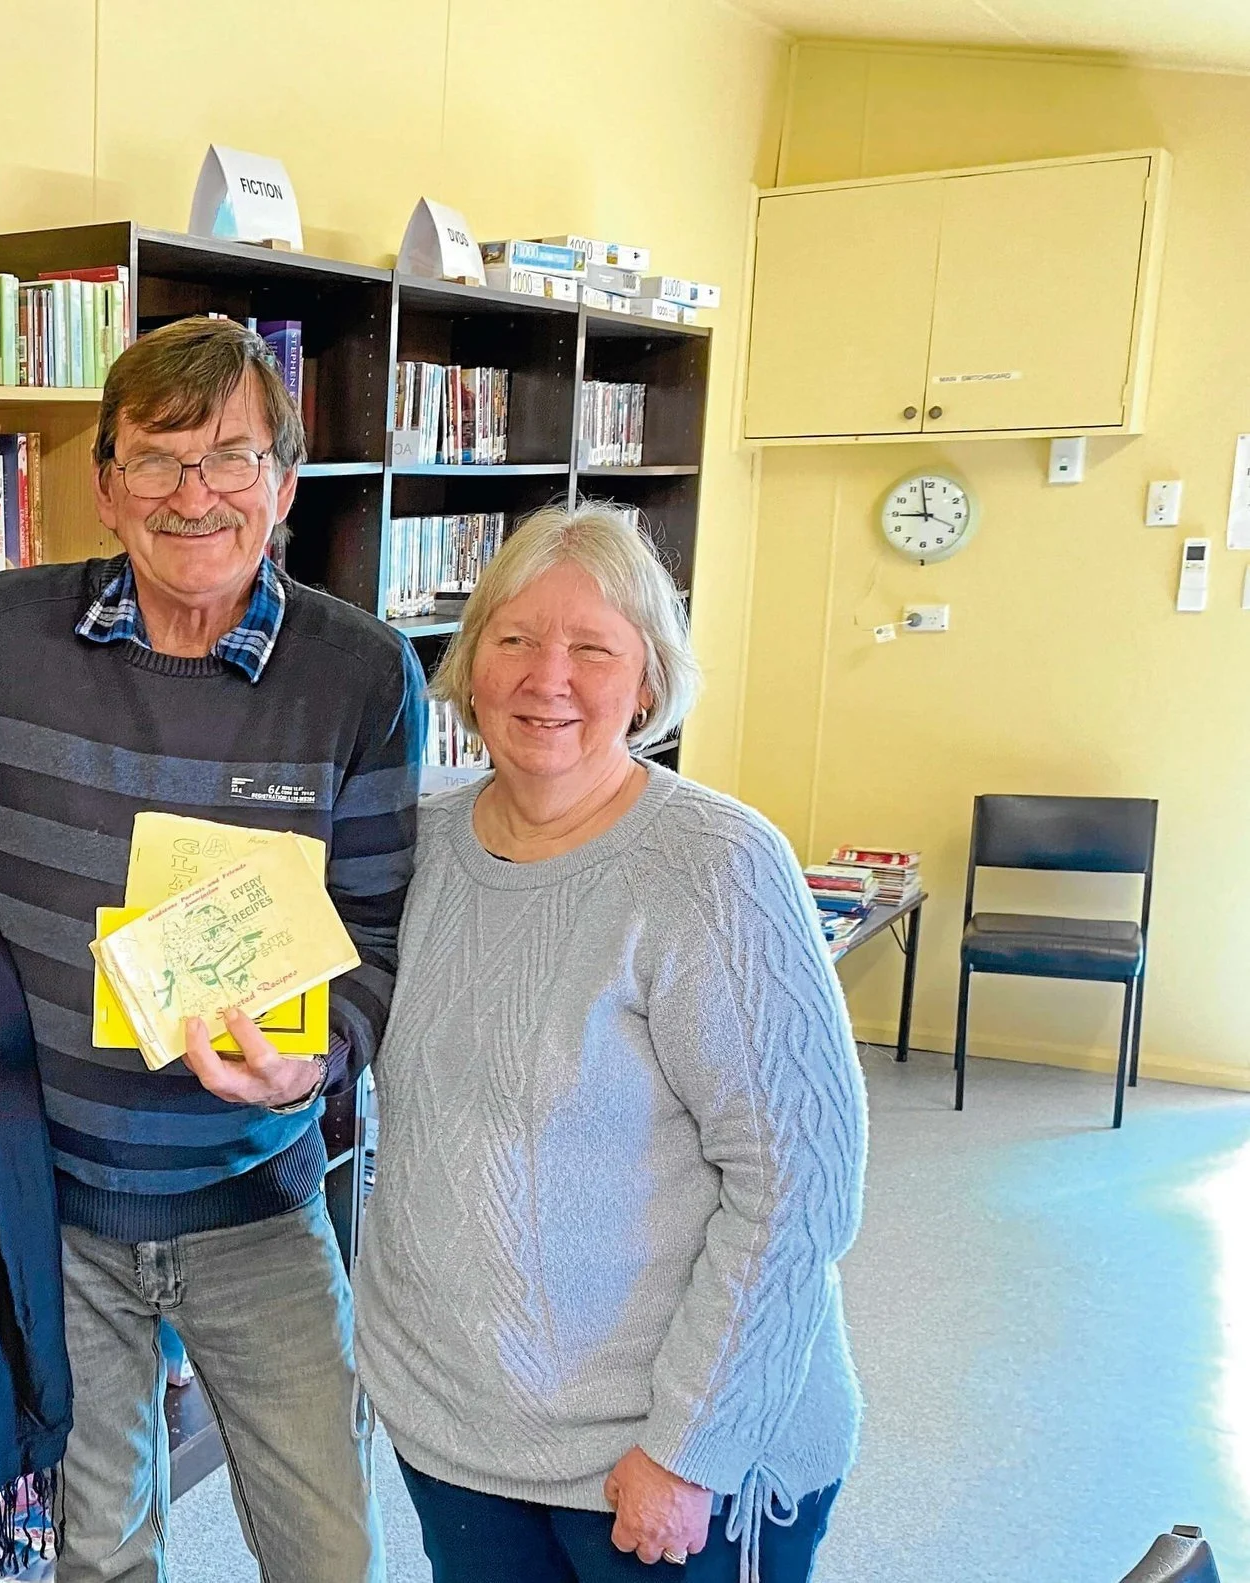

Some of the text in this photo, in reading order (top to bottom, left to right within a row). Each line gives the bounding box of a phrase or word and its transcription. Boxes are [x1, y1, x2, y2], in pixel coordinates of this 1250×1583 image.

[239, 177, 283, 200] FICTION
[447, 228, 469, 247] DVDS
[513, 272, 533, 294] 1000
[290, 331, 298, 388] STEPHEN
[230, 874, 263, 900] EVERY
[247, 885, 268, 903] DAY
[232, 896, 274, 924] RECIPES
[257, 969, 298, 992] Recipes
